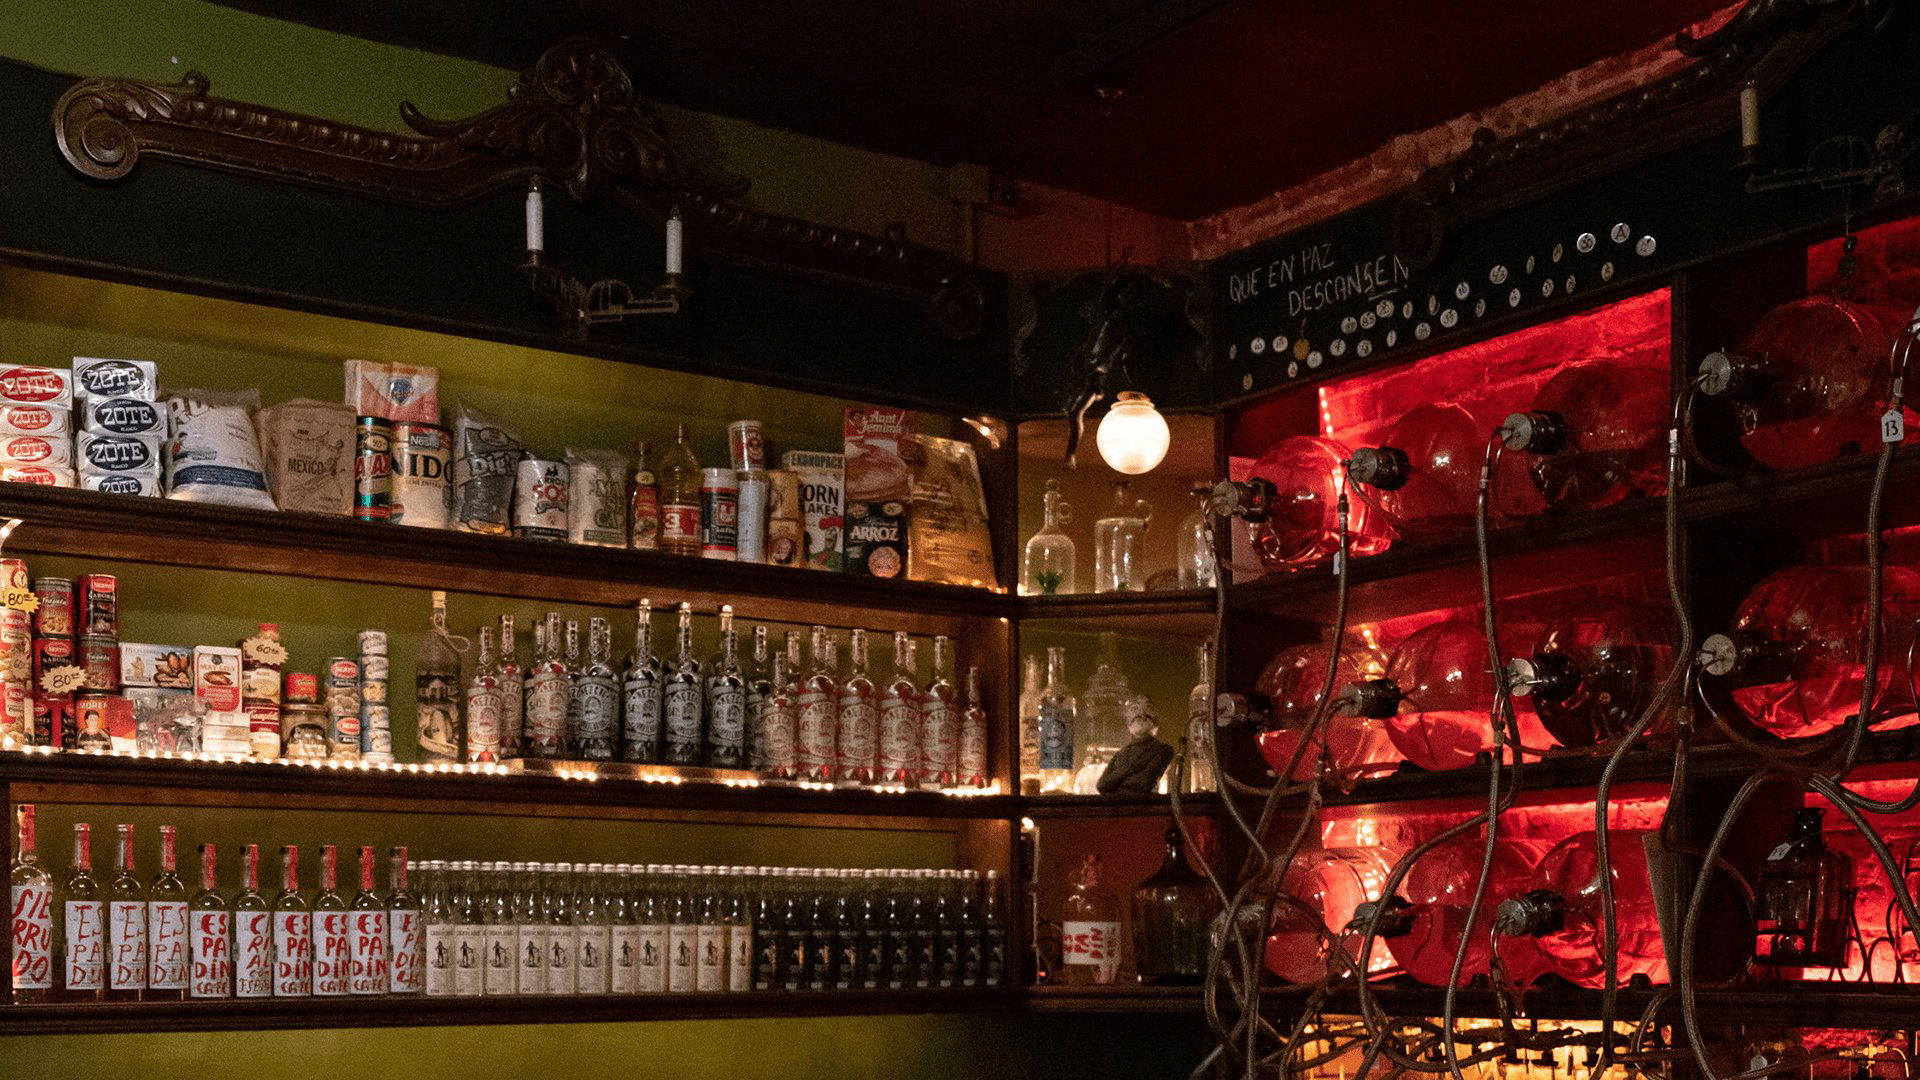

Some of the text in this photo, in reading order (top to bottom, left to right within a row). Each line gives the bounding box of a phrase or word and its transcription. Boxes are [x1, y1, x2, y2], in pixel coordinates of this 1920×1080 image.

[1230, 242, 1336, 304] QUE EN PAZ
[5, 375, 57, 395] ZOTE
[87, 367, 141, 390] ZOTE
[11, 411, 48, 424] ZOTE
[101, 405, 153, 426] ZOTE
[1885, 420, 1899, 437] 13
[11, 443, 48, 456] ZOTE
[92, 442, 144, 463] ZOTE
[102, 480, 139, 493] ZOTE
[850, 524, 899, 543] ARROZ
[53, 674, 71, 689] 80
[201, 913, 227, 936] ES
[286, 914, 310, 936] ES
[325, 913, 347, 936] ES
[357, 913, 383, 935] ES
[202, 936, 227, 958] PA
[287, 937, 310, 958] PA
[326, 936, 348, 958] PA
[358, 936, 383, 957] PA
